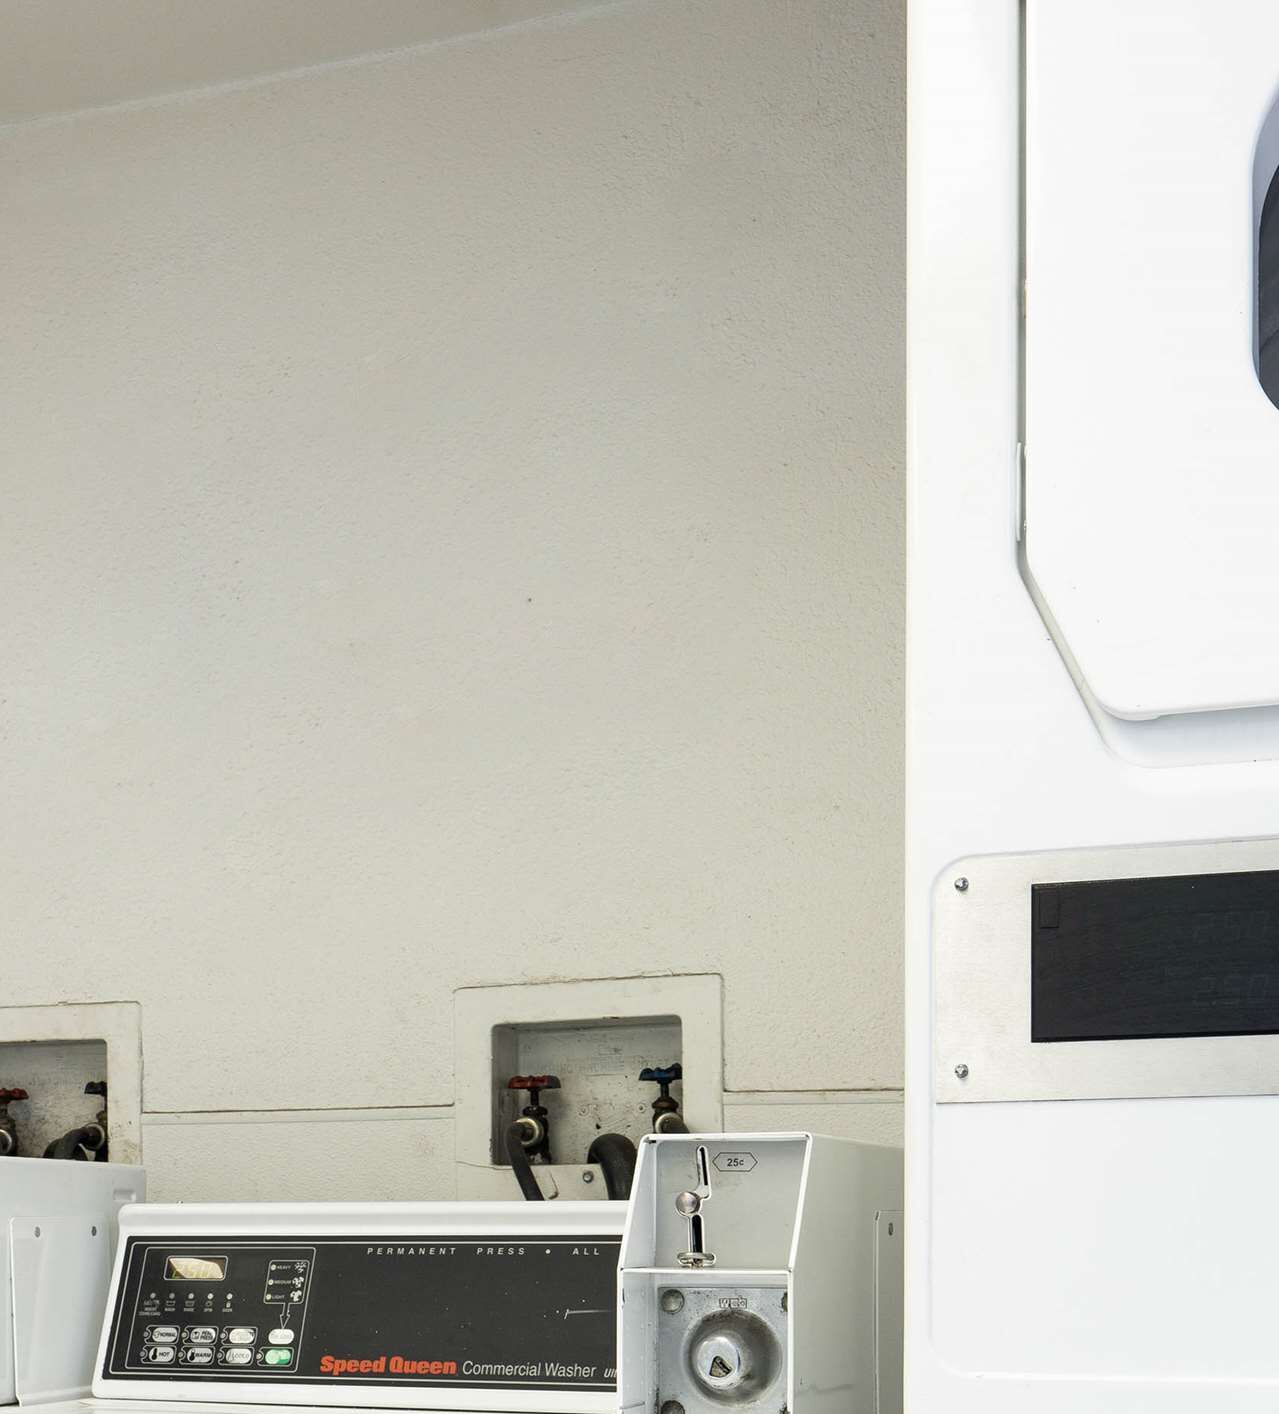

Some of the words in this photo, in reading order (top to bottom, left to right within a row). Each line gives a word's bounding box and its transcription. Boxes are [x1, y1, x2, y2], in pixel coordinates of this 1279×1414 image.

[367, 1247, 457, 1256] PERMANENT
[476, 1247, 525, 1256] PRESS
[572, 1247, 600, 1256] ALL
[320, 1355, 387, 1376] Speed
[389, 1356, 457, 1374] Queen
[462, 1360, 541, 1376] Commercial
[544, 1361, 597, 1378] Washer
